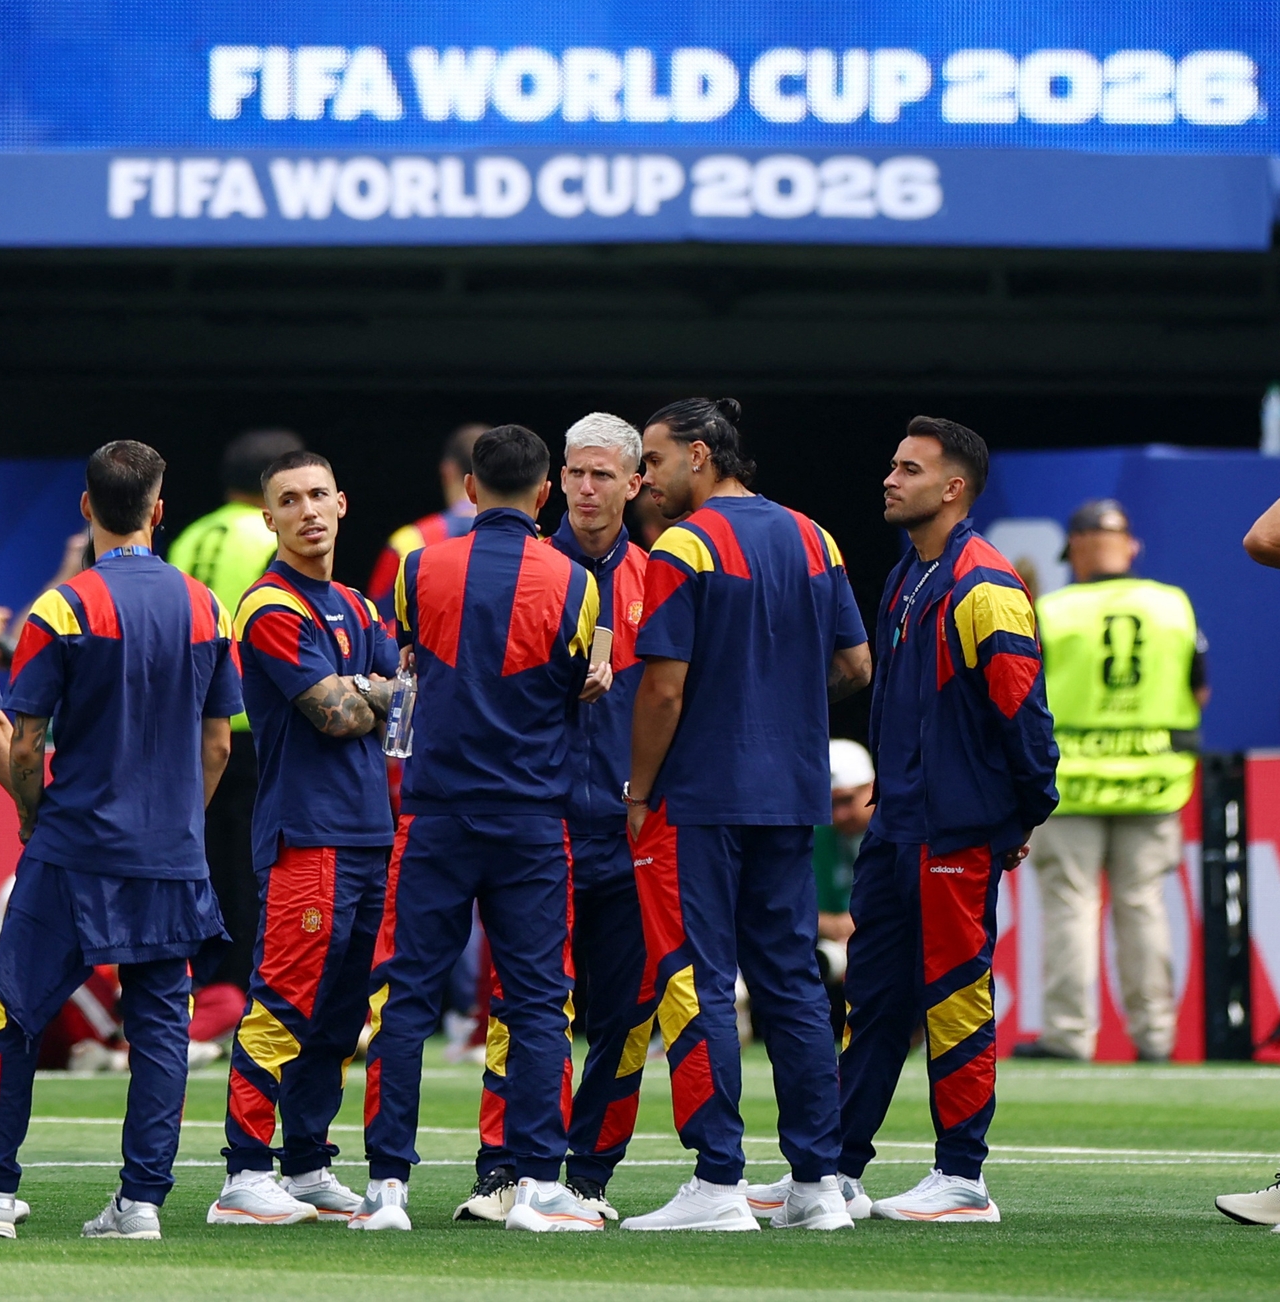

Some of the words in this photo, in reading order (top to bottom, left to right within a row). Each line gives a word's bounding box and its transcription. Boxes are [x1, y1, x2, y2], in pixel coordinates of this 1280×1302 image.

[209, 45, 404, 120] FIFA
[408, 46, 739, 122] WORLD
[749, 47, 932, 123] CUP
[942, 48, 1260, 125] 2026
[108, 157, 266, 218] FIFA
[268, 156, 532, 220] WORLD
[537, 154, 685, 217] CUP
[689, 155, 944, 220] 2026
